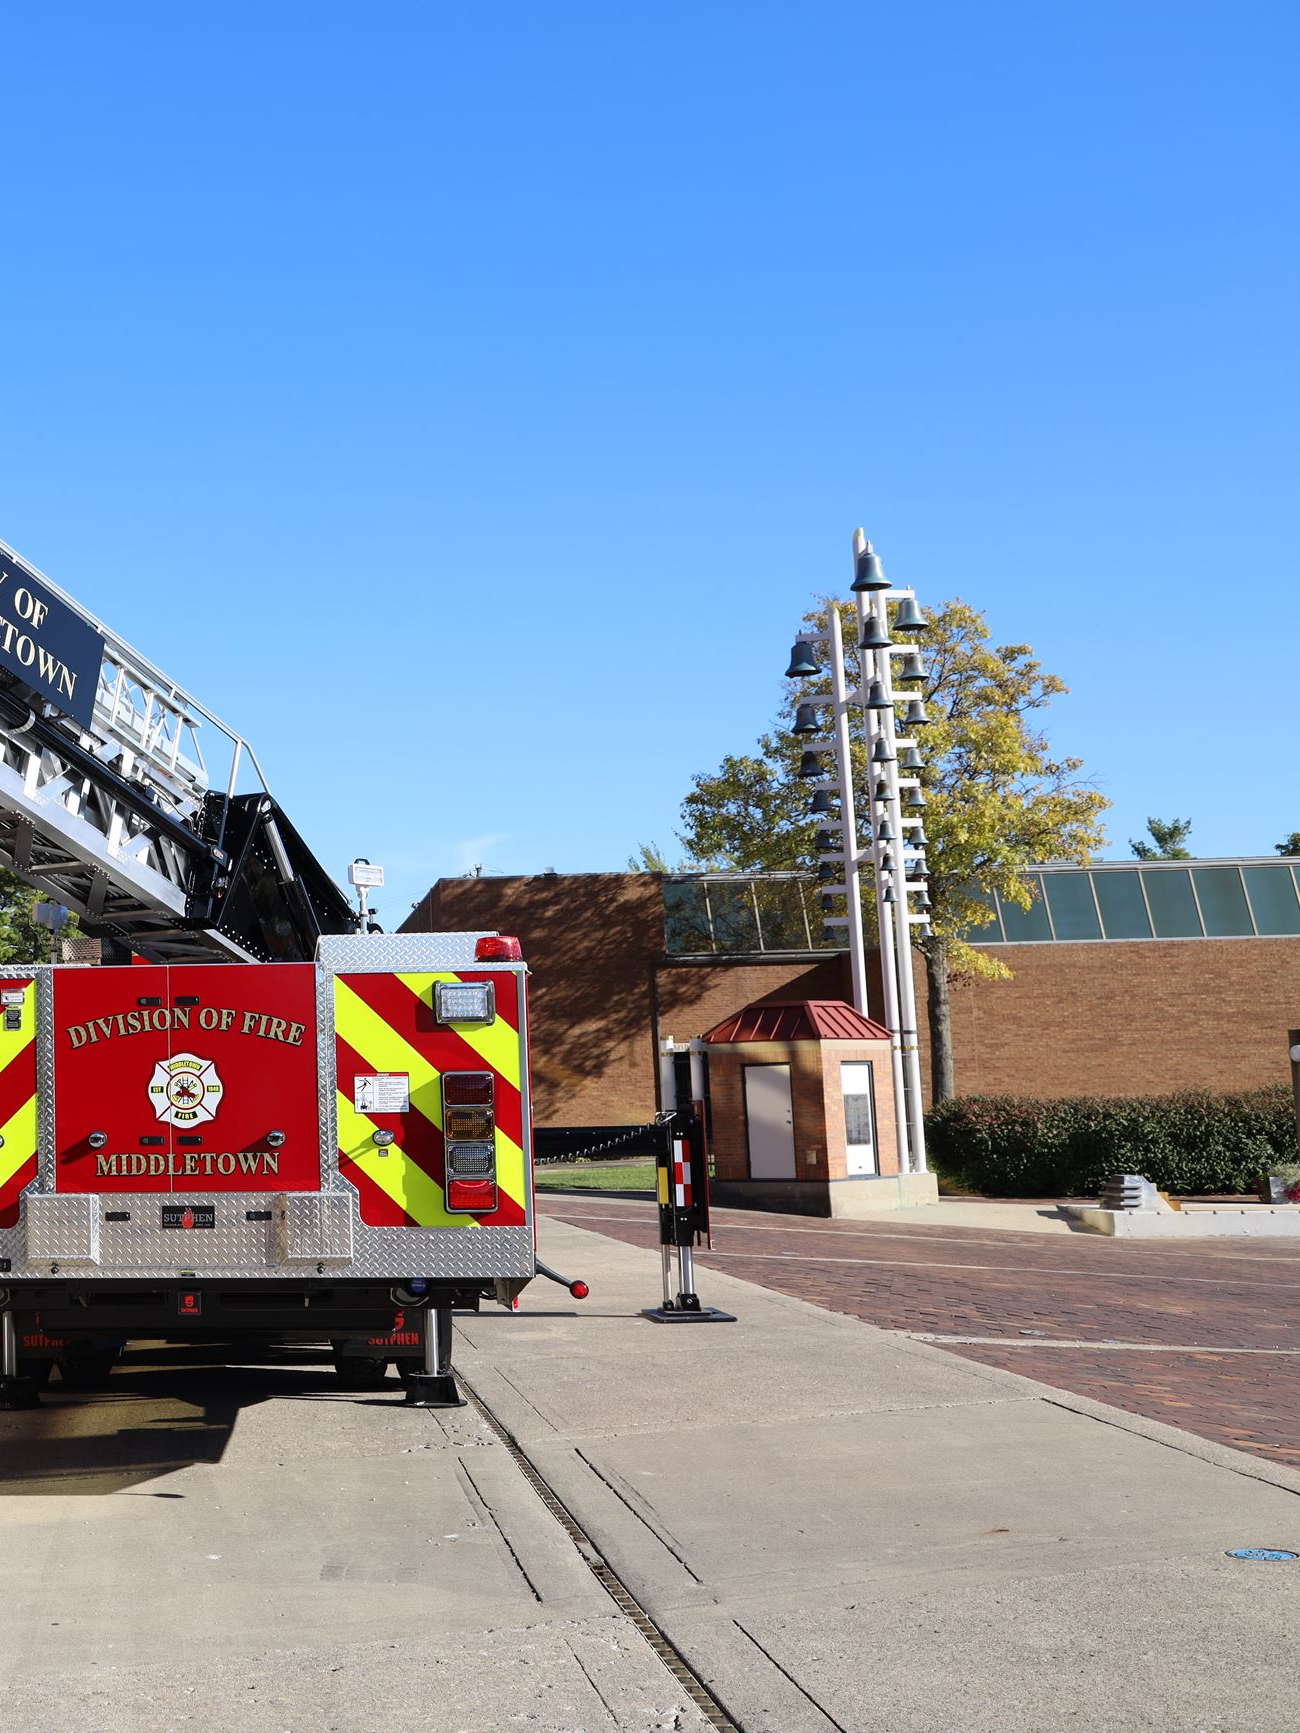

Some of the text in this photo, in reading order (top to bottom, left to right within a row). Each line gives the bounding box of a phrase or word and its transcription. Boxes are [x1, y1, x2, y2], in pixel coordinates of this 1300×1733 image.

[14, 587, 49, 630] OF
[66, 1007, 306, 1050] DIVISION OF FIRE
[95, 1151, 280, 1177] MIDDLETOWN
